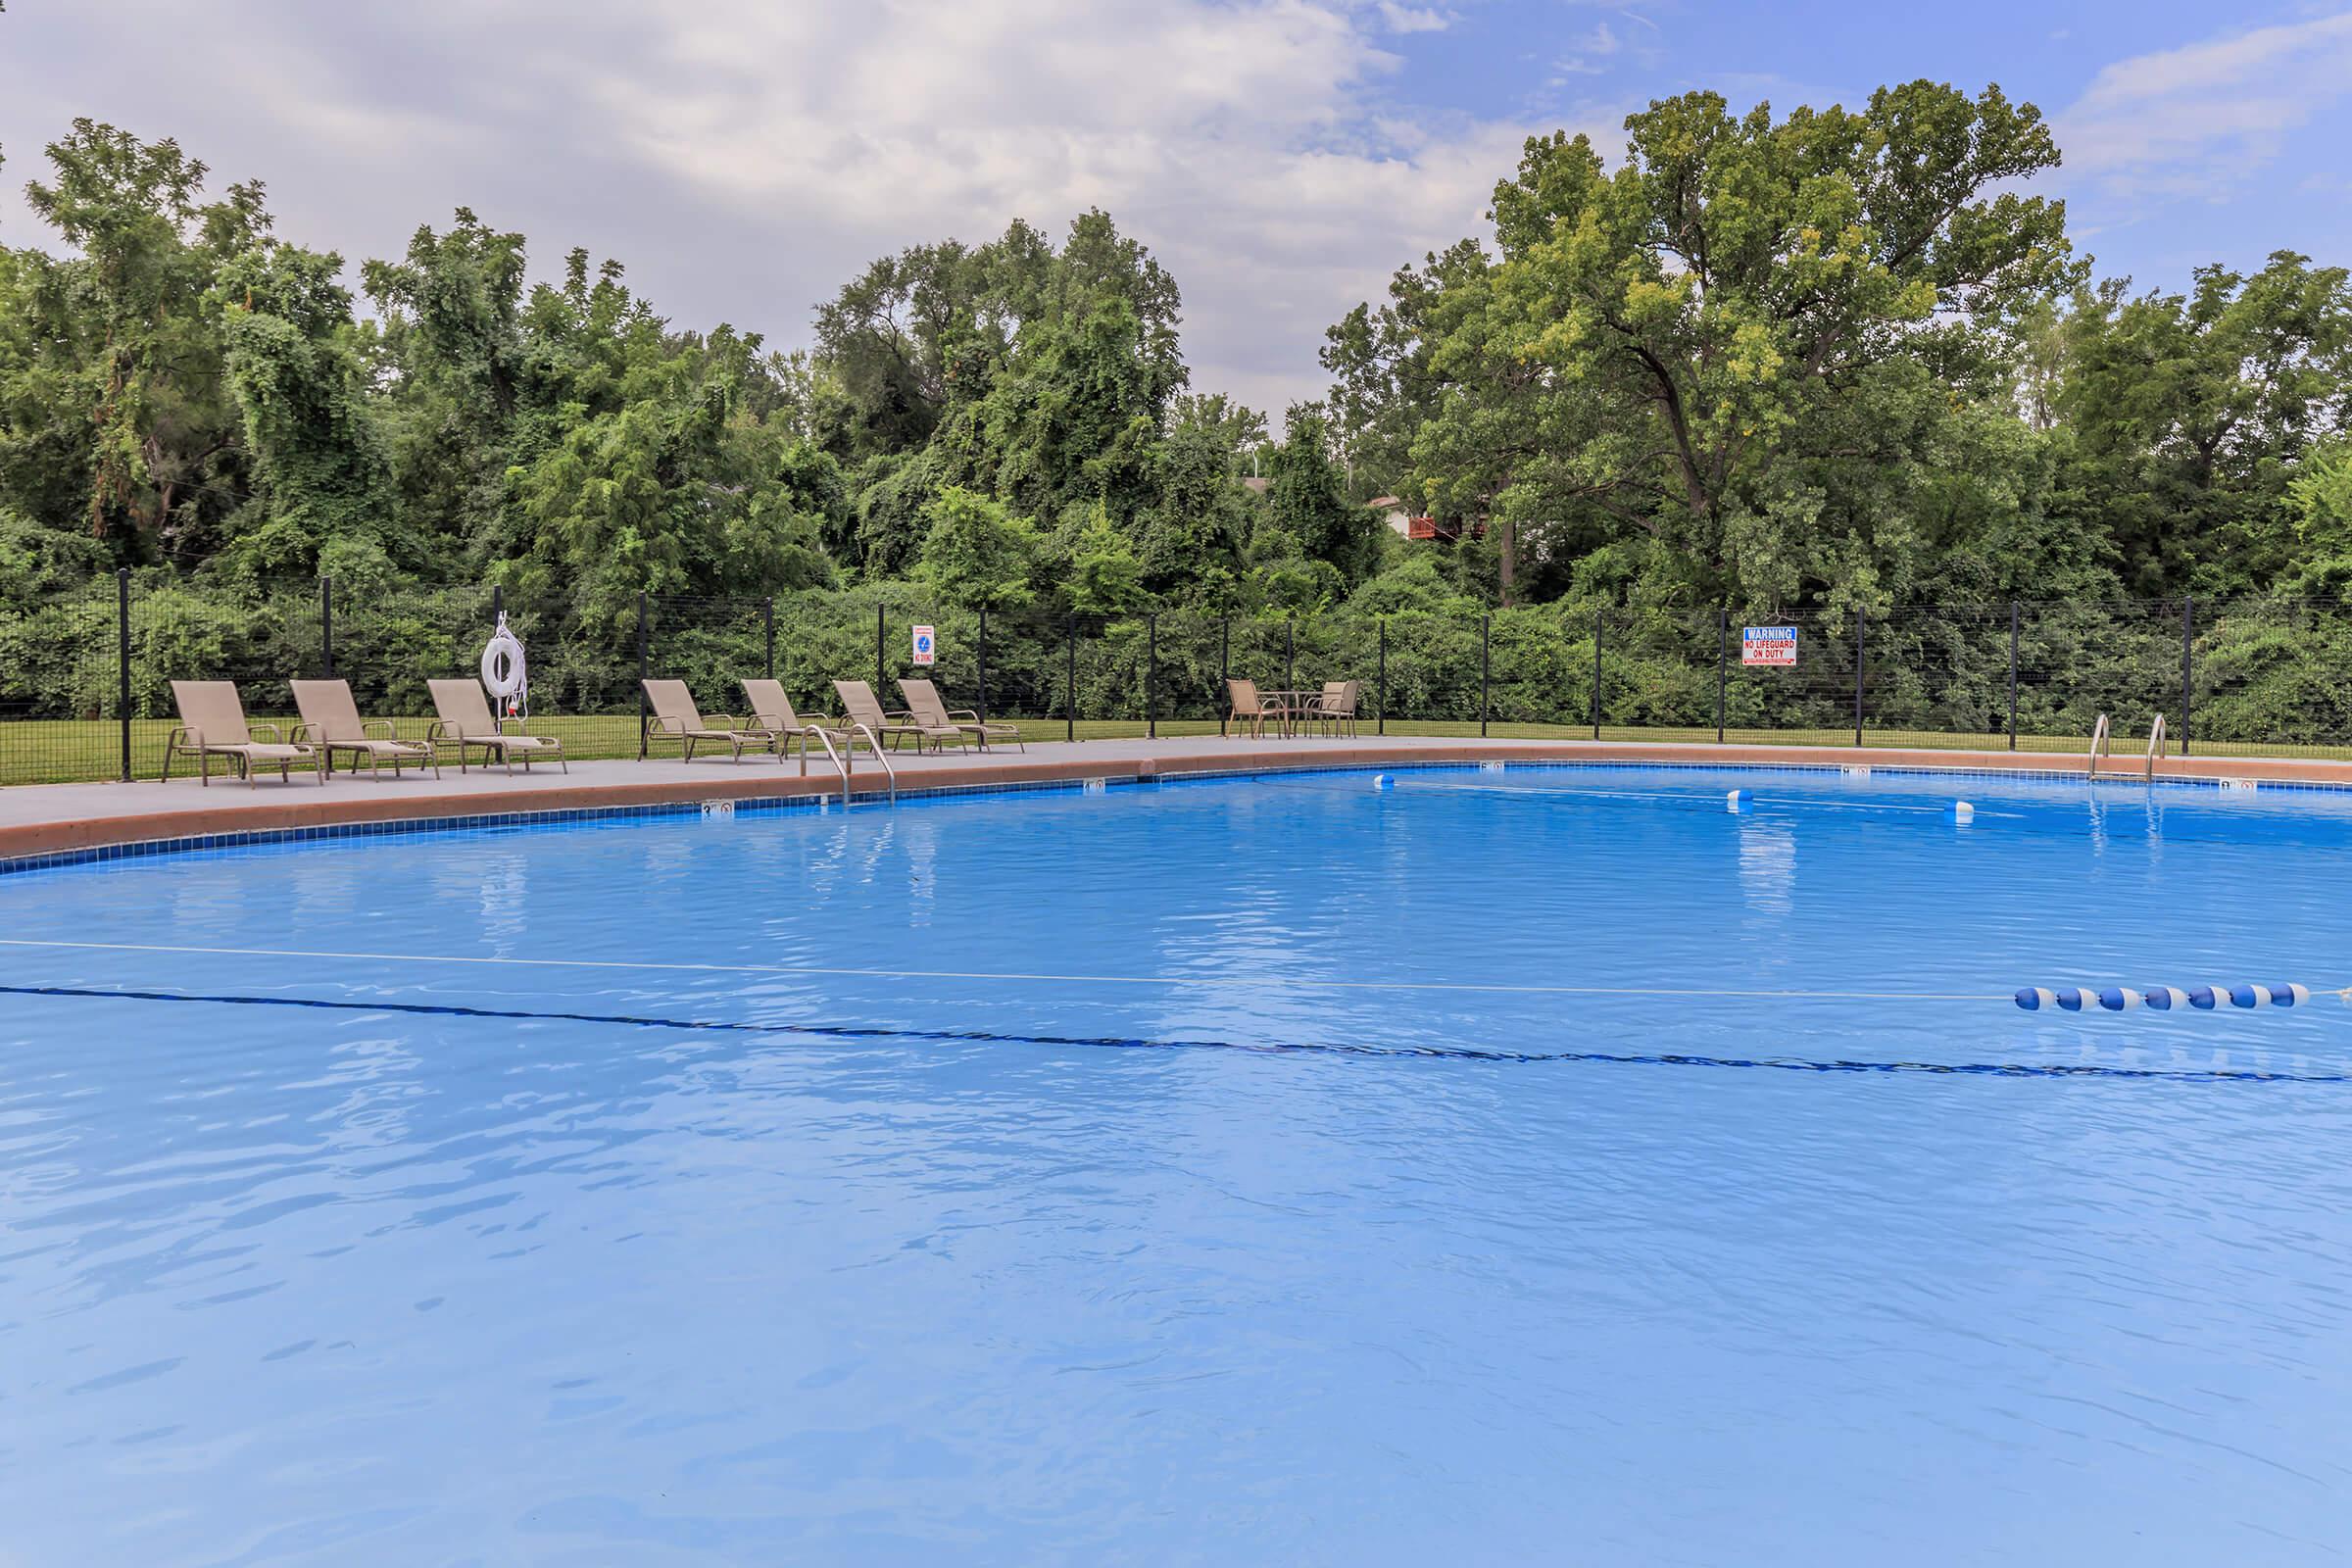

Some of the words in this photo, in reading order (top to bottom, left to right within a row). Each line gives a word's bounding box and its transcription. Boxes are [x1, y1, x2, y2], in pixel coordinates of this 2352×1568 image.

[1747, 628, 1792, 639] WARNING
[1744, 640, 1754, 649] NO
[1756, 640, 1794, 649] LIFEGUARD
[1753, 649, 1763, 658] ON
[1765, 649, 1784, 658] DUTY
